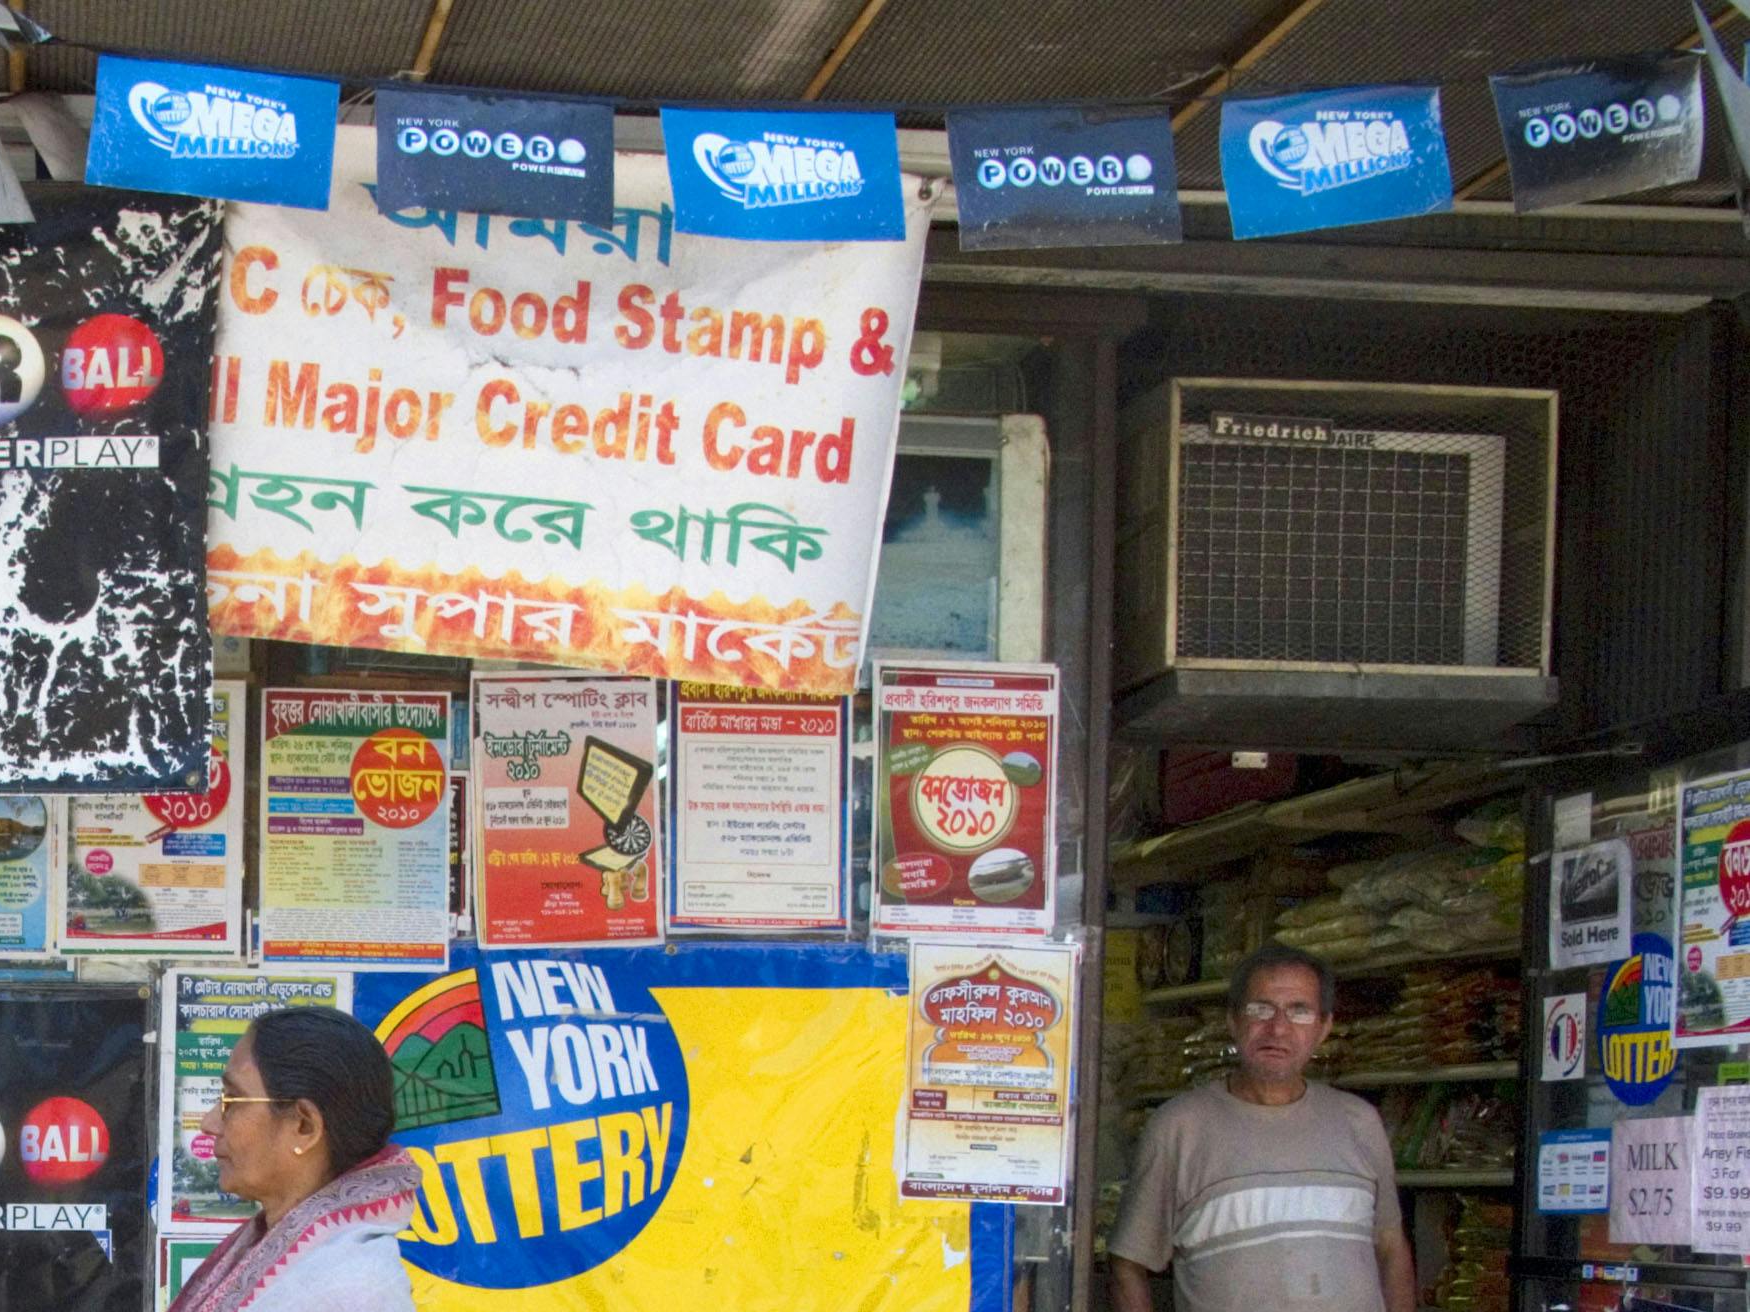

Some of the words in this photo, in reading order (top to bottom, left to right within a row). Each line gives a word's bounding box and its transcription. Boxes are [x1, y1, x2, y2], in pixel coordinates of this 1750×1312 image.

[205, 84, 242, 100] NEW
[187, 91, 297, 143] MEGA
[397, 117, 423, 127] NEW
[428, 118, 460, 128] YORK
[1316, 111, 1349, 121] NEW
[1518, 108, 1541, 119] NEW
[1544, 102, 1571, 114] YORK
[1527, 101, 1652, 145] POWER
[171, 131, 297, 159] MILLIONS
[401, 130, 552, 160] POWER
[762, 131, 800, 146] NEW
[973, 148, 999, 158] NEW
[1004, 145, 1034, 157] YORK
[1301, 120, 1410, 166] MEGA
[748, 141, 861, 185] MEGA
[981, 157, 1120, 186] POWER
[1301, 150, 1412, 197] MILLIONS
[744, 179, 864, 210] MILLIONS
[431, 266, 592, 345] Food
[613, 282, 826, 385] Stamp
[850, 305, 895, 378] &
[264, 360, 453, 455] Major
[474, 378, 681, 466] Credit
[701, 401, 857, 485] Card
[1215, 415, 1328, 442] Friedrich
[403, 483, 597, 551] করে
[630, 501, 830, 574] থাকি
[351, 582, 581, 647] সুপার
[800, 717, 834, 734] ২০১০
[369, 737, 428, 765] বন
[353, 766, 444, 803] ভোজন
[508, 761, 540, 783] ২০১০
[920, 774, 1007, 808] বনভোজন
[161, 797, 212, 823] ২০১০
[377, 805, 420, 822] ২০১০
[936, 806, 996, 836] ২০১০
[1561, 928, 1583, 948] Sold
[1587, 926, 1619, 943] Here
[490, 959, 620, 1022] NEW
[929, 979, 1001, 1005] তাফসীরুল
[939, 1001, 998, 1025] মাহফিল
[1003, 1008, 1045, 1029] ২০১০
[1643, 988, 1673, 1025] YOR
[505, 1028, 659, 1112] YORK
[1602, 1030, 1678, 1084] LOTTER
[1626, 1142, 1679, 1173] MILK
[397, 1102, 674, 1248] OTTERY
[1627, 1187, 1675, 1217] $2.75
[1703, 1186, 1750, 1200] $9.99
[1706, 1222, 1742, 1233] $9.99
